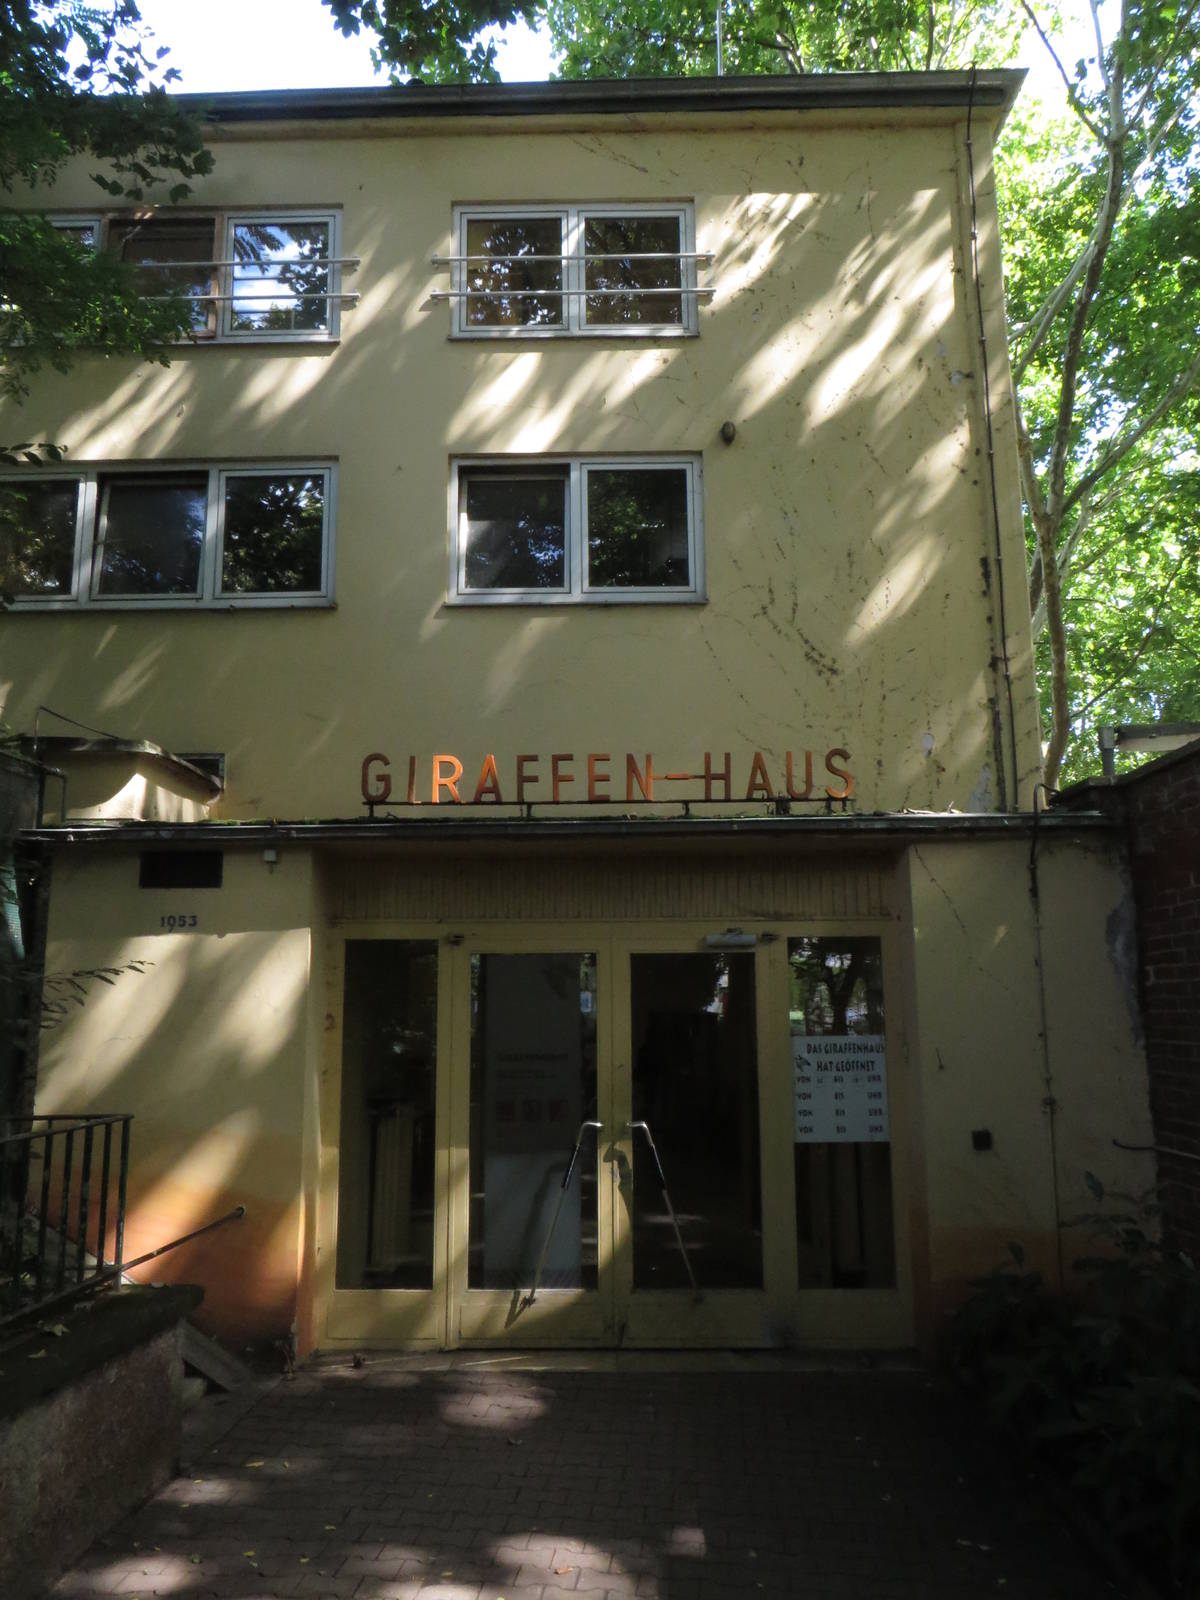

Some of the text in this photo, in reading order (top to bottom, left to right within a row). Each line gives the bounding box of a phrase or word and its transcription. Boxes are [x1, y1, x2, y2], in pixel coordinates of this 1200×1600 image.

[361, 748, 855, 804] GIRAFFEN-HAUS
[160, 915, 197, 933] 1953
[807, 1043, 822, 1054] DAS
[816, 1060, 833, 1072] HAT
